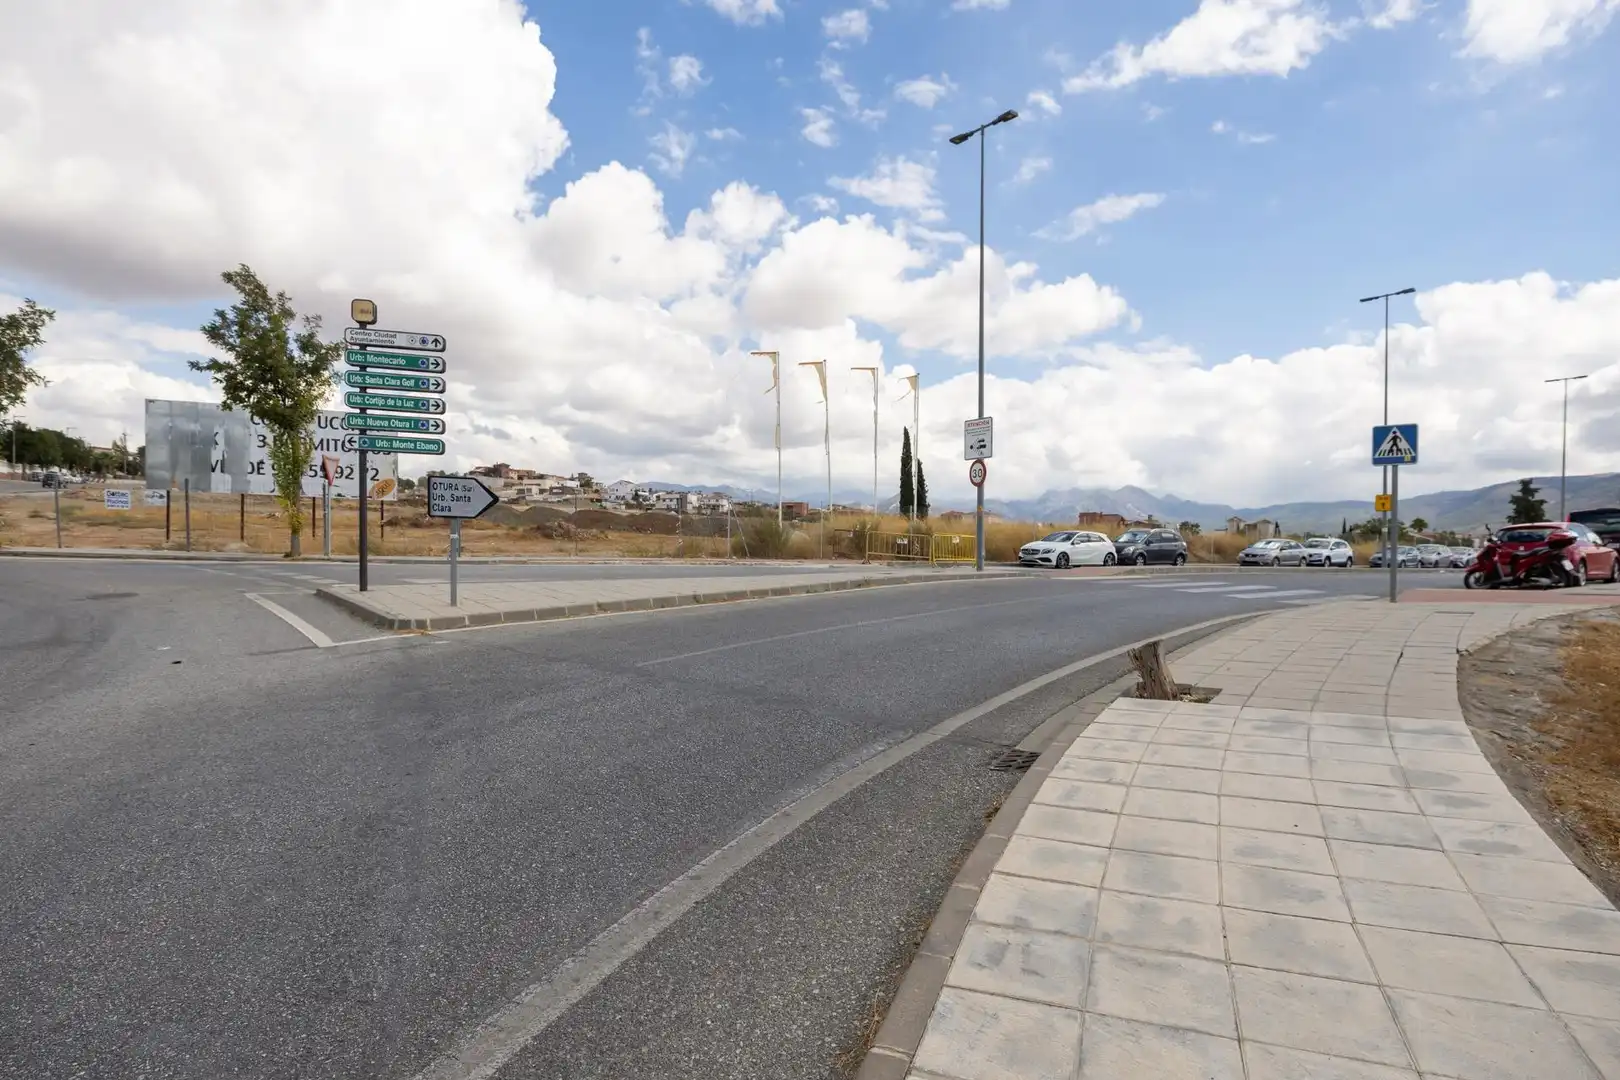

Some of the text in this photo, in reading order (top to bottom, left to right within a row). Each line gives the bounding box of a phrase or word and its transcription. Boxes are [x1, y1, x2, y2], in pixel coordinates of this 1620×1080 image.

[349, 329, 397, 339] Centro Ciudad
[349, 336, 395, 345] Ayuntamiento
[349, 353, 406, 366] Urb: Montecarlo
[364, 375, 383, 385] Santa
[384, 377, 400, 386] Clara
[401, 378, 415, 387] Golf
[364, 396, 386, 407] Cortijo
[386, 398, 395, 406] de
[395, 398, 402, 406] la
[403, 399, 415, 408] Luz
[349, 417, 365, 426] Urb:
[366, 418, 389, 427] Nueva
[390, 419, 410, 428] Otura
[392, 440, 415, 449] Monte
[972, 468, 983, 479] 30
[432, 482, 459, 491] OTURA
[432, 493, 471, 502] Urb. Santa
[432, 503, 452, 512] Clara
